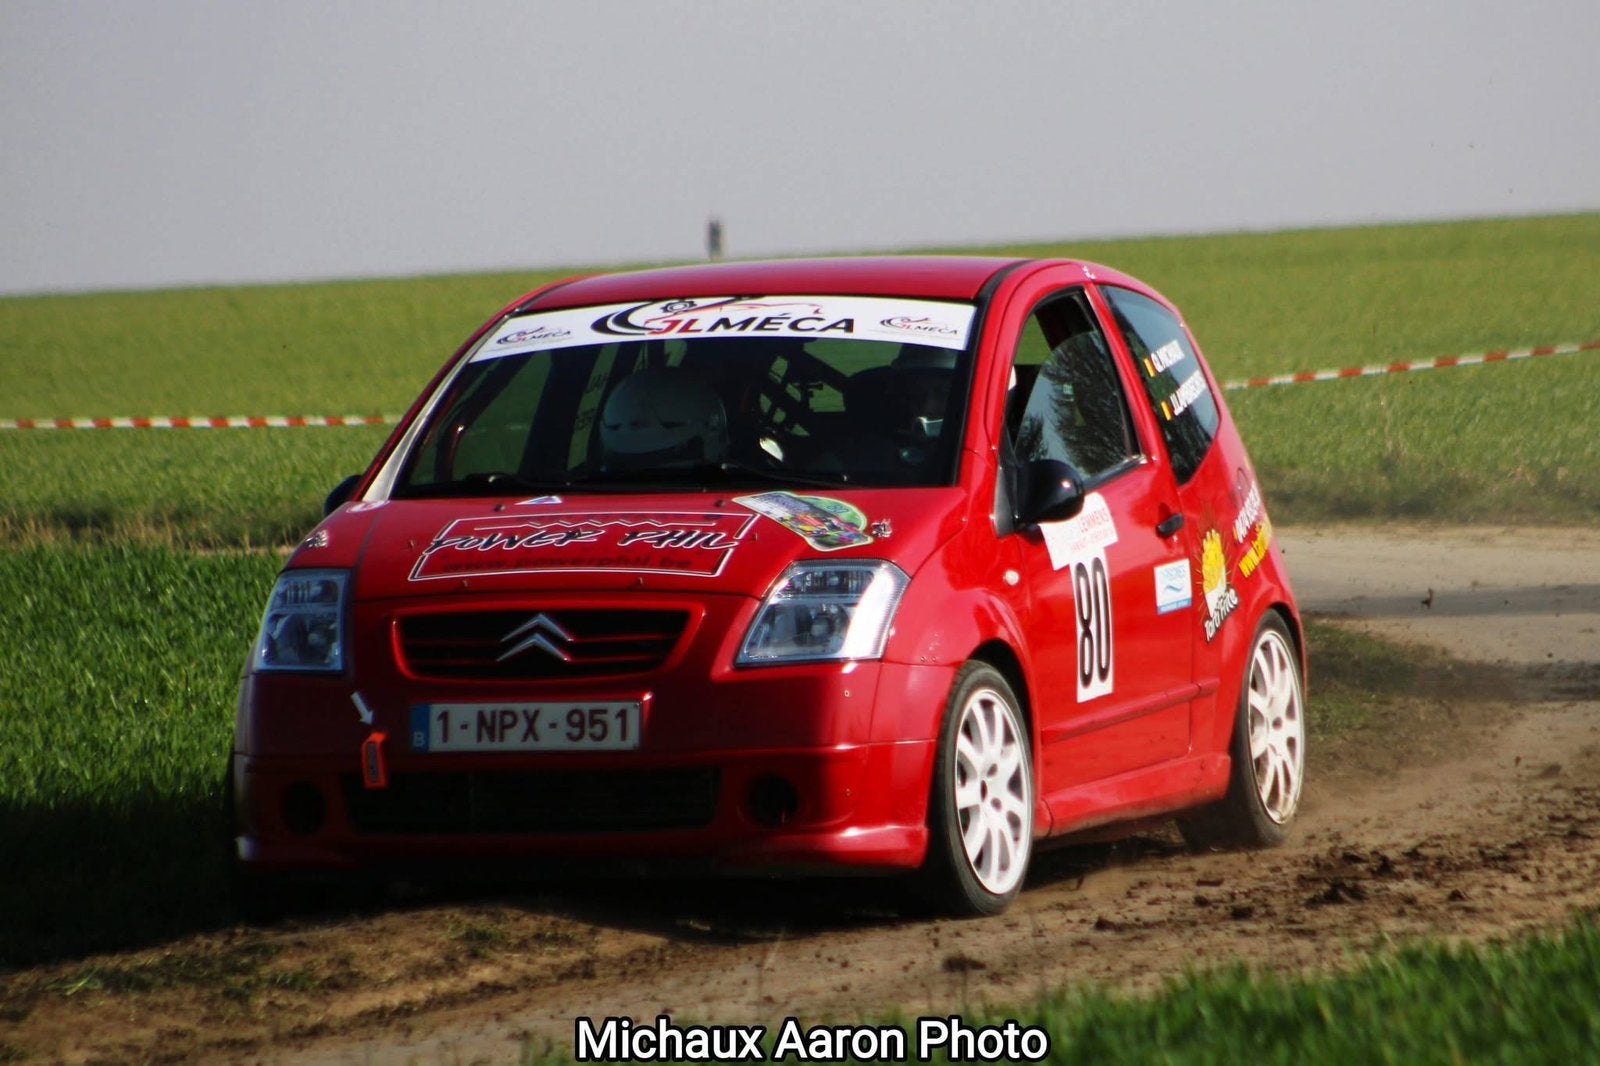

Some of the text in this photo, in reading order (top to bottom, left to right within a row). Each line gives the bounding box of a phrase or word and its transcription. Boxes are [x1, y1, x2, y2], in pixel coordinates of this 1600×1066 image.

[423, 528, 739, 555] POWER PHIL
[1074, 556, 1111, 689] 80
[412, 708, 628, 747] B 1-NPX-951
